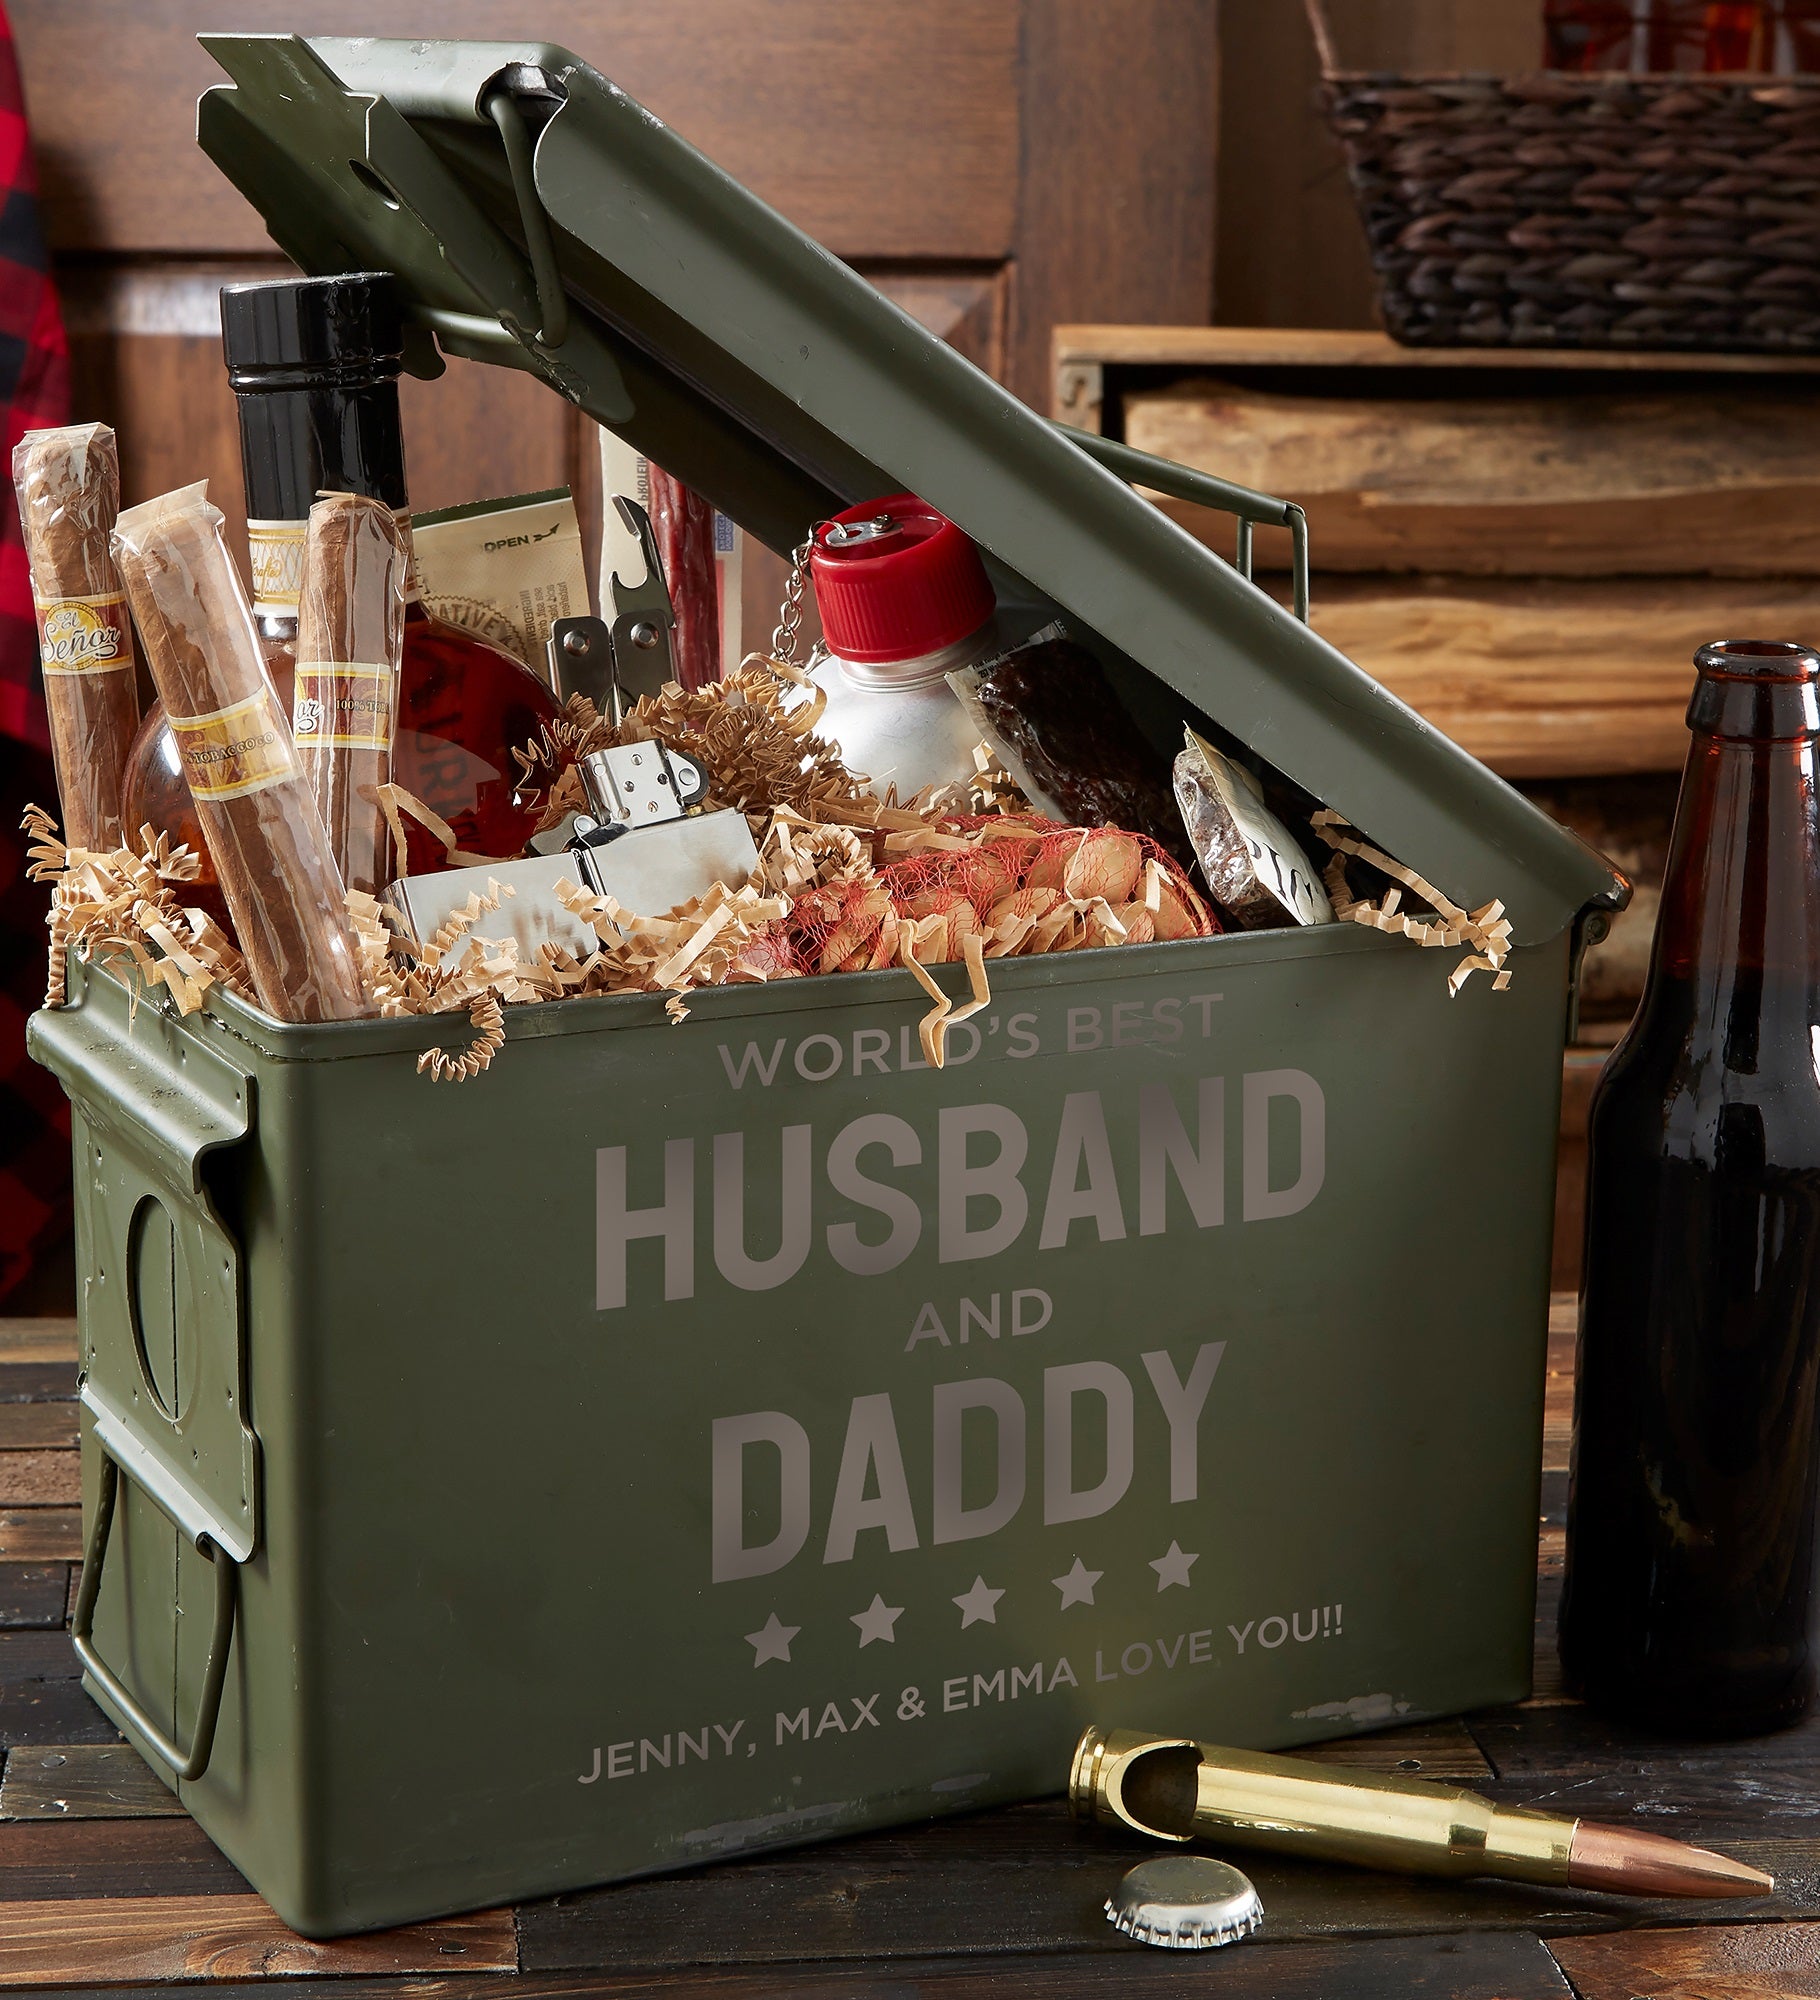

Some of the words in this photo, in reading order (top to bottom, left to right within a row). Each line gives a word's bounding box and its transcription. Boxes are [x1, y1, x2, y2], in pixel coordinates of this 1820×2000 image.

[484, 535, 530, 552] OPEN
[43, 622, 120, 664] Señor
[56, 611, 79, 630] El
[335, 698, 366, 713] 100%
[717, 1012, 1040, 1090] WORLD'S
[1067, 993, 1224, 1052] BEST
[595, 1068, 1326, 1310] HUSBAND
[904, 1287, 1053, 1352] AND
[712, 1340, 1227, 1584] DADDY
[577, 1719, 756, 1784] JENNY,
[776, 1693, 880, 1745] MAX
[897, 1686, 926, 1720] &
[943, 1657, 1078, 1712] EMMA
[1095, 1629, 1213, 1683] LOVE
[1227, 1604, 1343, 1655] YOU!!
